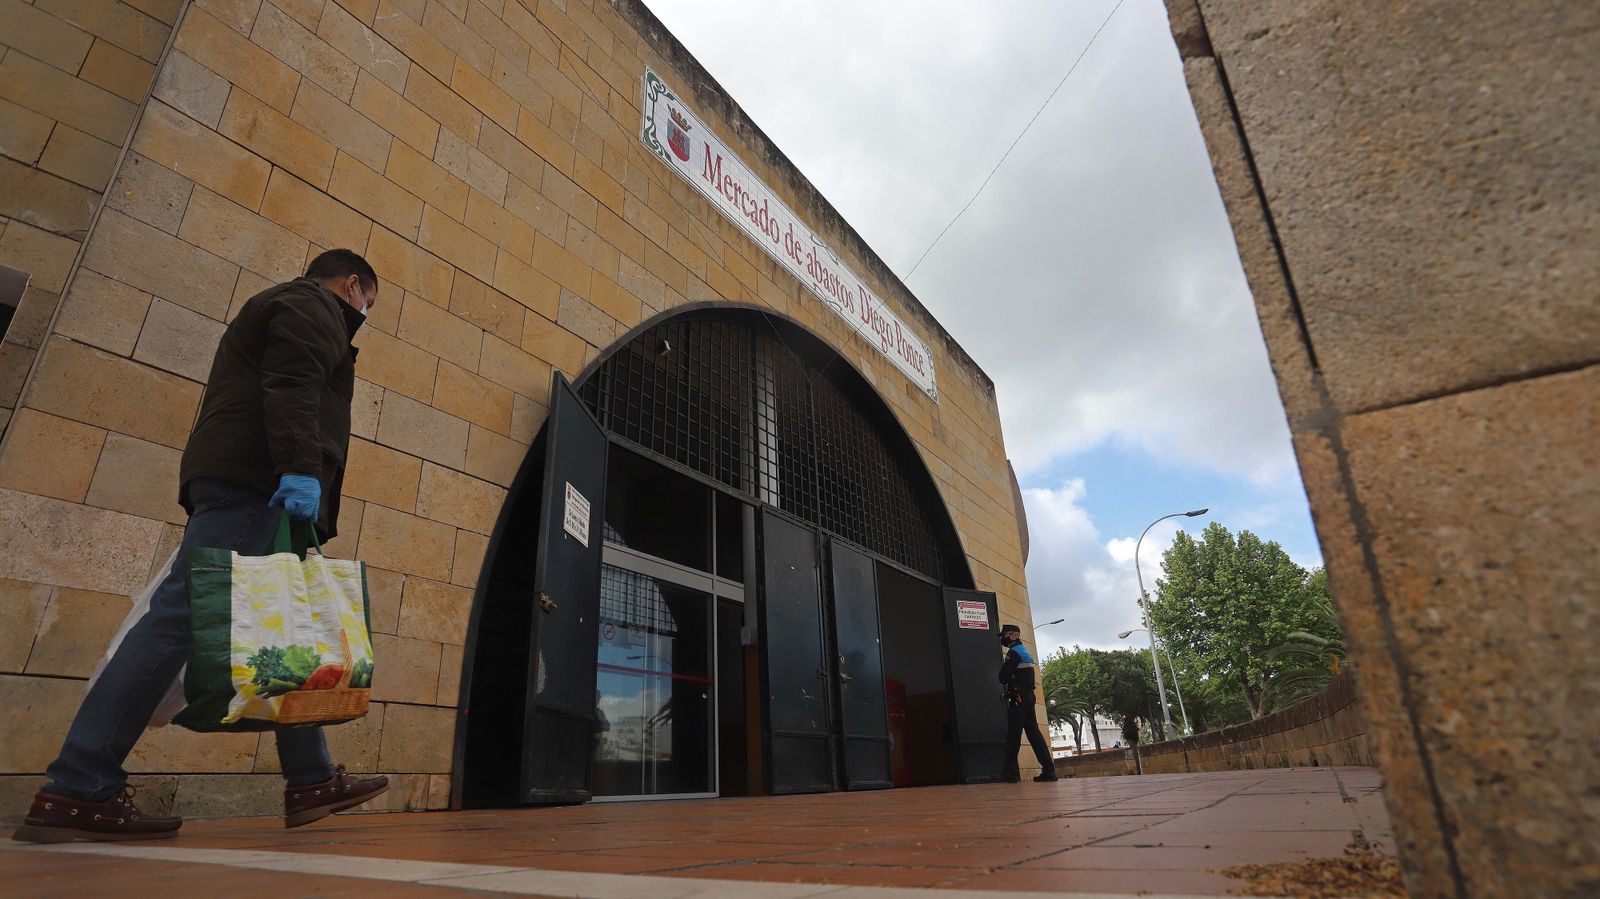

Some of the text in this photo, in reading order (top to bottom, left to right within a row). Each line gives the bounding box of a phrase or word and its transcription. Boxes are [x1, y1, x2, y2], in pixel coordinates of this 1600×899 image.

[702, 142, 926, 377] Mercado de abastos Diego Ponce
